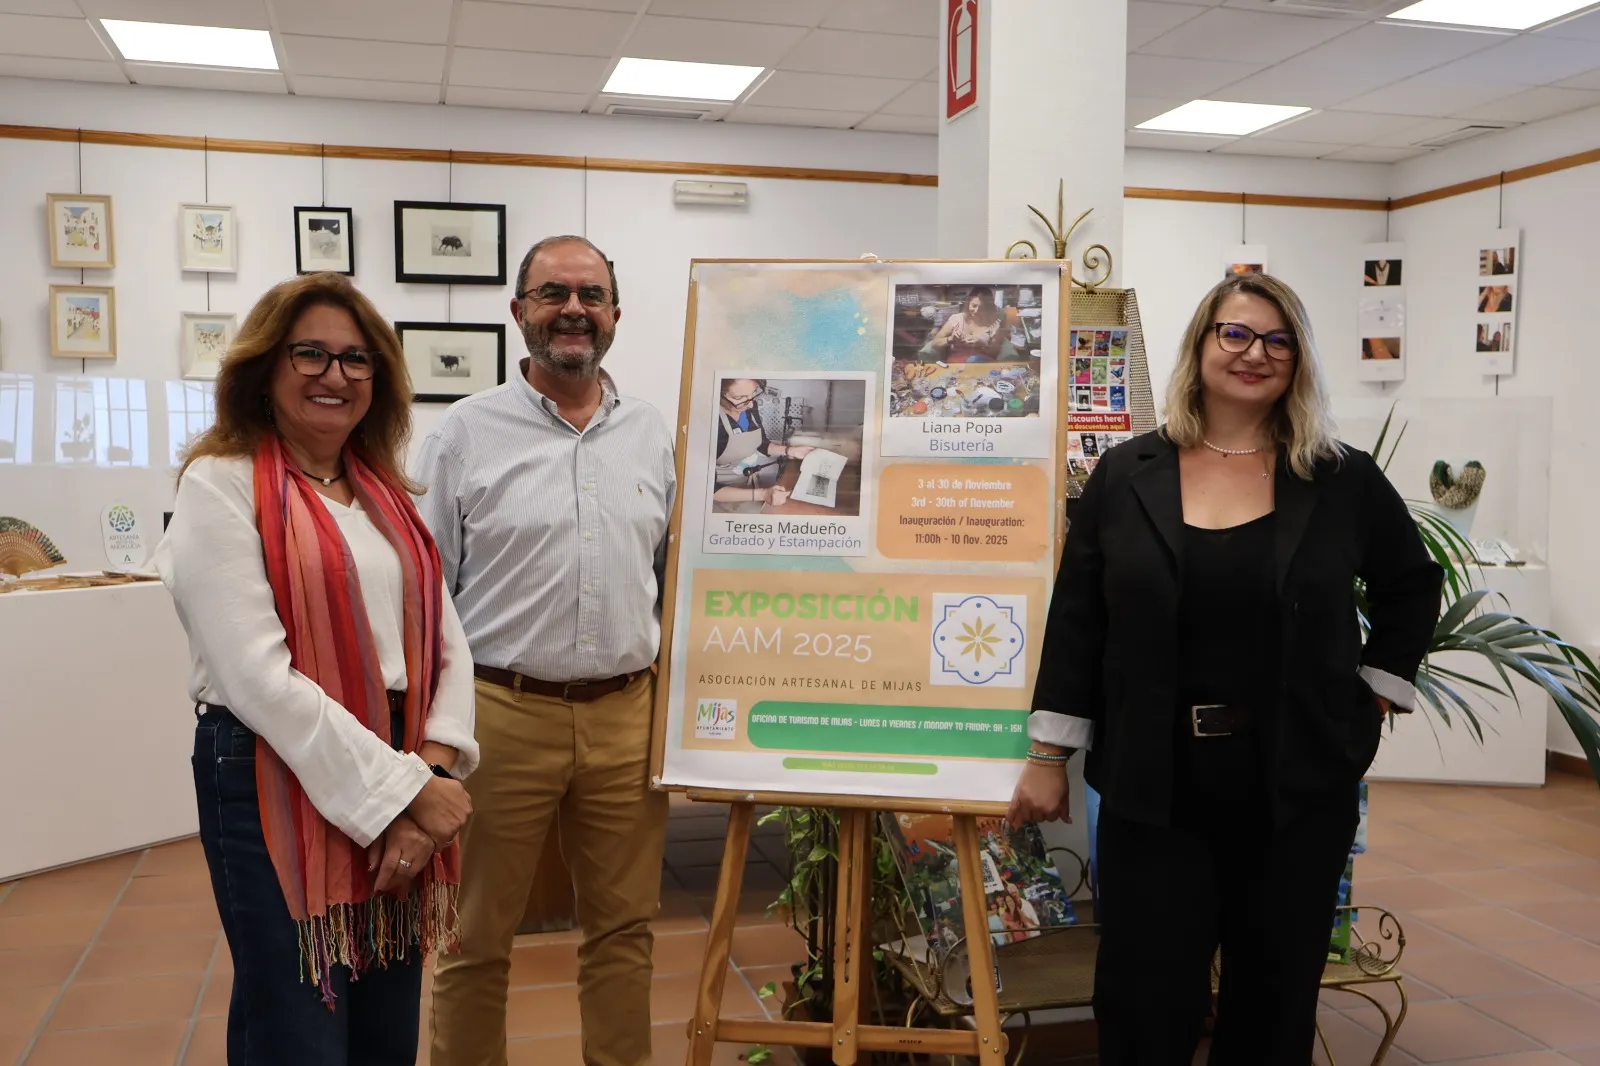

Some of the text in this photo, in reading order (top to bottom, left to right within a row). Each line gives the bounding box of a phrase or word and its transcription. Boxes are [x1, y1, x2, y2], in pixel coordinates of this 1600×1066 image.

[1104, 415, 1125, 423] here!
[922, 421, 1002, 437] Liana Popa
[930, 438, 994, 452] Bisutería
[918, 479, 1012, 490] 3 al 30 de Noviembre
[911, 497, 926, 507] 3rd
[936, 497, 956, 507] 30th
[958, 498, 968, 507] of
[970, 498, 1014, 508] November
[725, 520, 847, 535] Teresa Madueño
[899, 515, 1025, 528] Inauguración / Inauguration:
[709, 534, 861, 550] Grabado y Estampación
[915, 533, 941, 544] 11:00h
[951, 534, 960, 544] 10
[963, 535, 982, 545] Nov.
[985, 535, 1008, 545] 2025
[704, 588, 919, 622] EXPOSICIÓN
[702, 625, 872, 663] AAM 2025
[699, 674, 922, 692] ASOCIACIÓN ARTESANAL DE MIJAS
[697, 702, 735, 725] Mijas
[752, 715, 777, 723] OFICINA
[779, 716, 787, 724] DE
[789, 716, 819, 725] TURISMO
[821, 717, 829, 725] DE
[831, 718, 852, 726] MIJAS
[860, 719, 880, 727] LUNES
[882, 719, 887, 727] A
[889, 720, 916, 728] VIERNES
[924, 721, 953, 730] MONDAY
[955, 722, 964, 730] TO
[994, 723, 1002, 731] 9H
